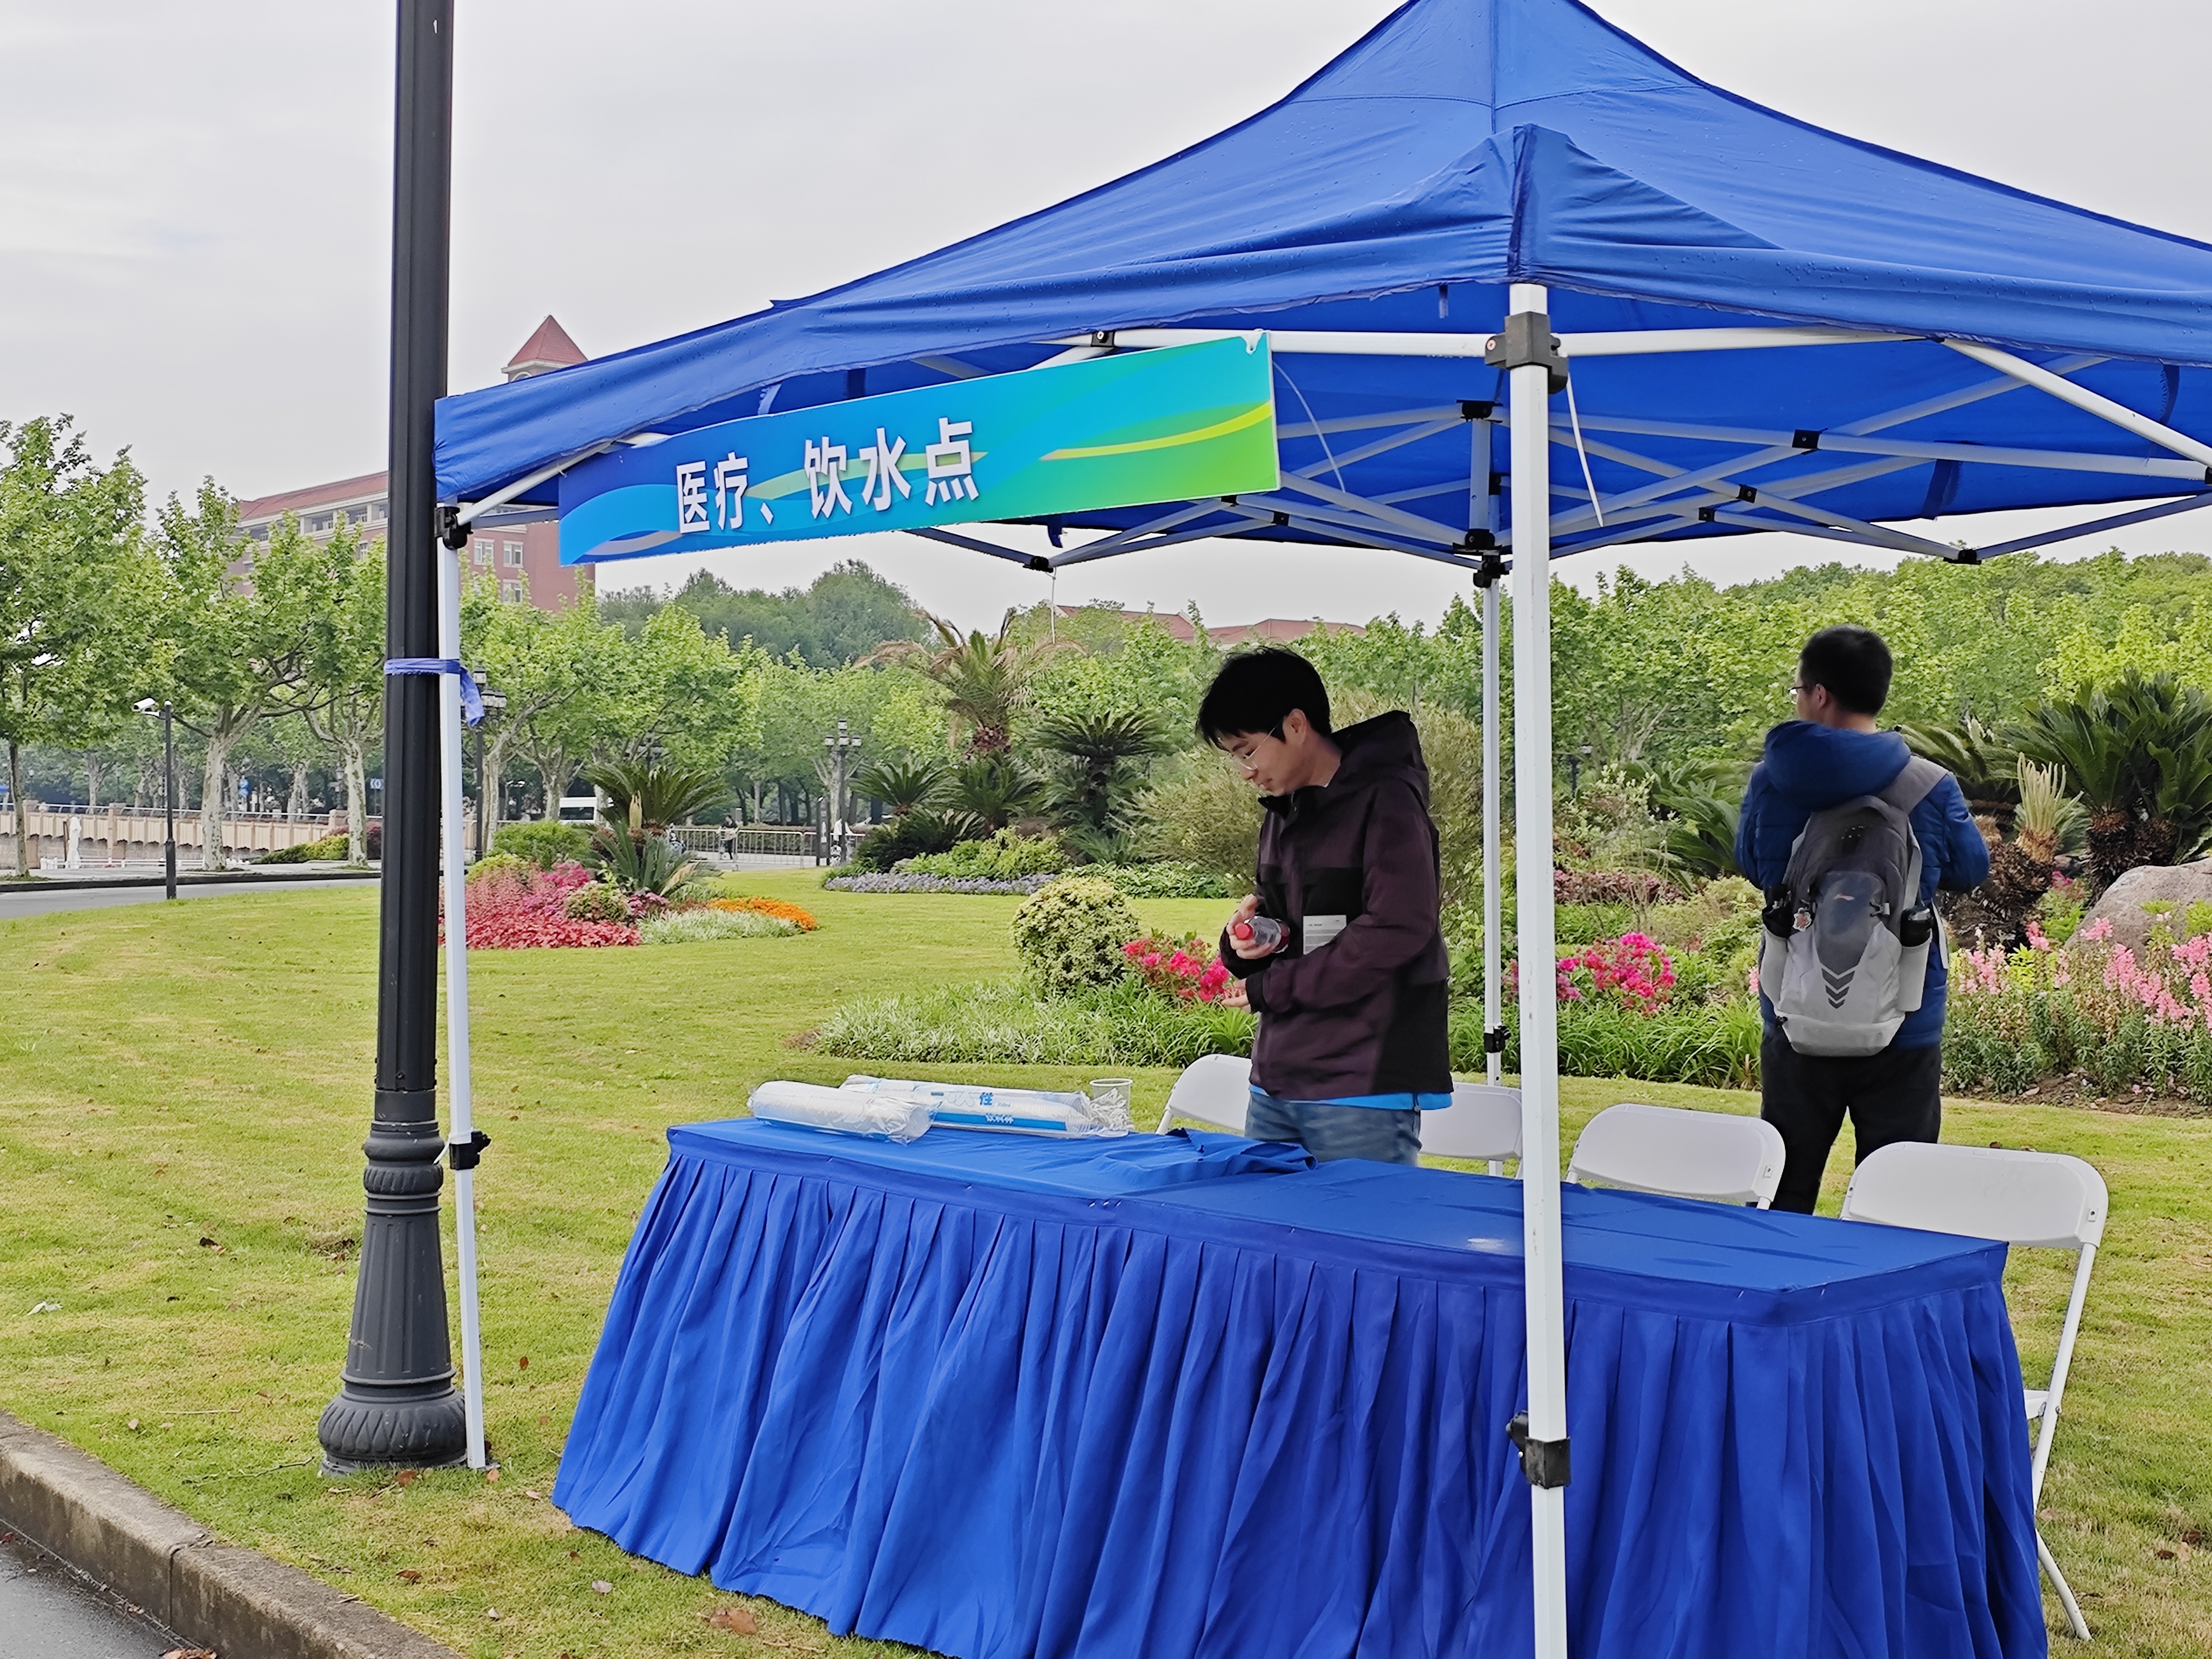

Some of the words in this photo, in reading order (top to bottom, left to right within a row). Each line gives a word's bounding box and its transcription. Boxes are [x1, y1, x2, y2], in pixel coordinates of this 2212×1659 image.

[676, 417, 979, 534] 医疗、饮水点
